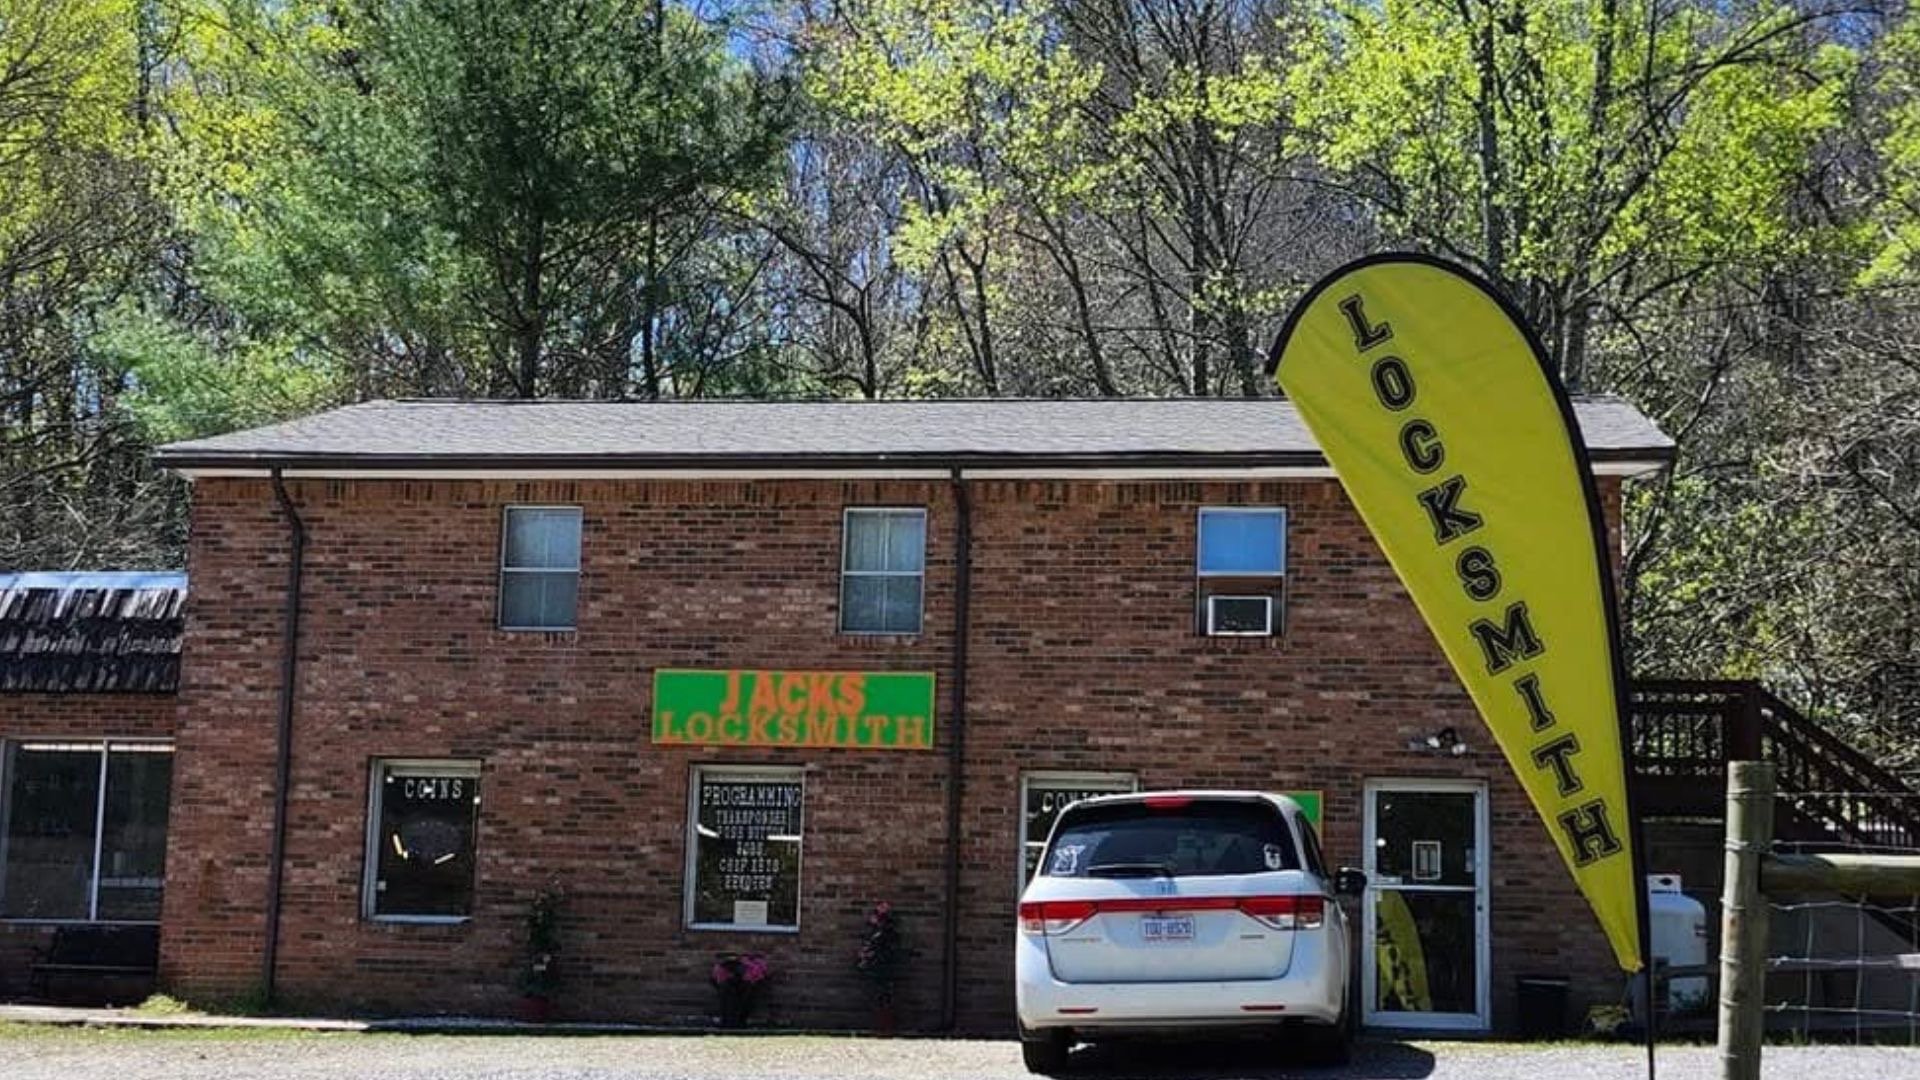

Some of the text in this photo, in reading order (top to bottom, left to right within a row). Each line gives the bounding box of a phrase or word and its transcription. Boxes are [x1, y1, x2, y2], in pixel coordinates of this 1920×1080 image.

[1338, 293, 1624, 868] LOCKSMITH
[719, 670, 867, 716] JACKS
[658, 711, 926, 747] LOCKSMITH
[404, 778, 463, 800] COINS
[703, 785, 802, 808] PROGRAMMING
